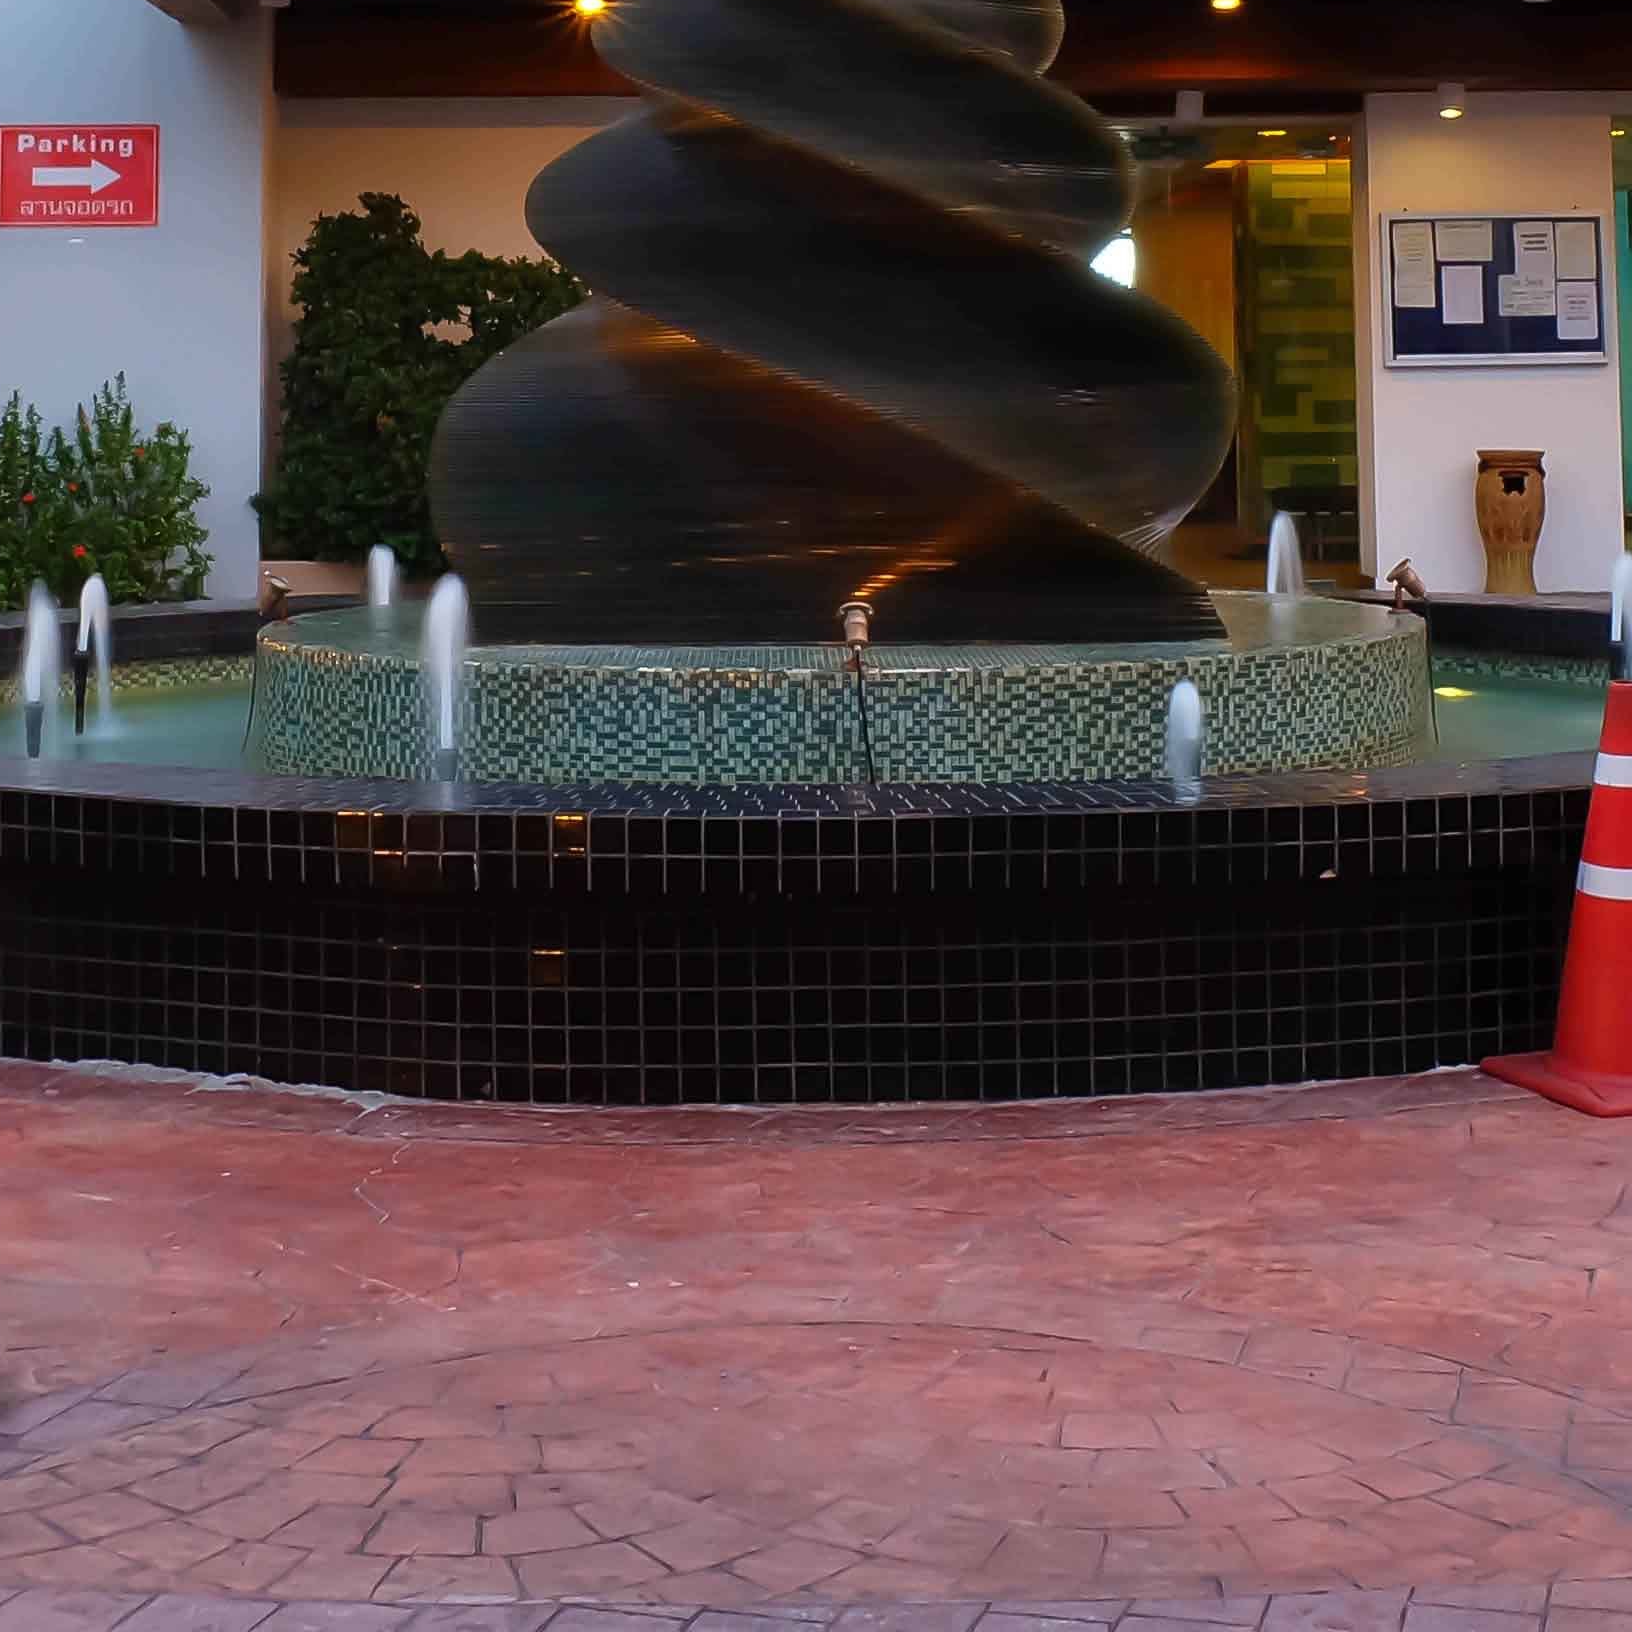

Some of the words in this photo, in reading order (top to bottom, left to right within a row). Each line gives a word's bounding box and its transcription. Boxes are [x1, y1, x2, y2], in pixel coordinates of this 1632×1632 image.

[17, 134, 133, 157] Parking
[20, 199, 134, 216] ลานจอดรถ
